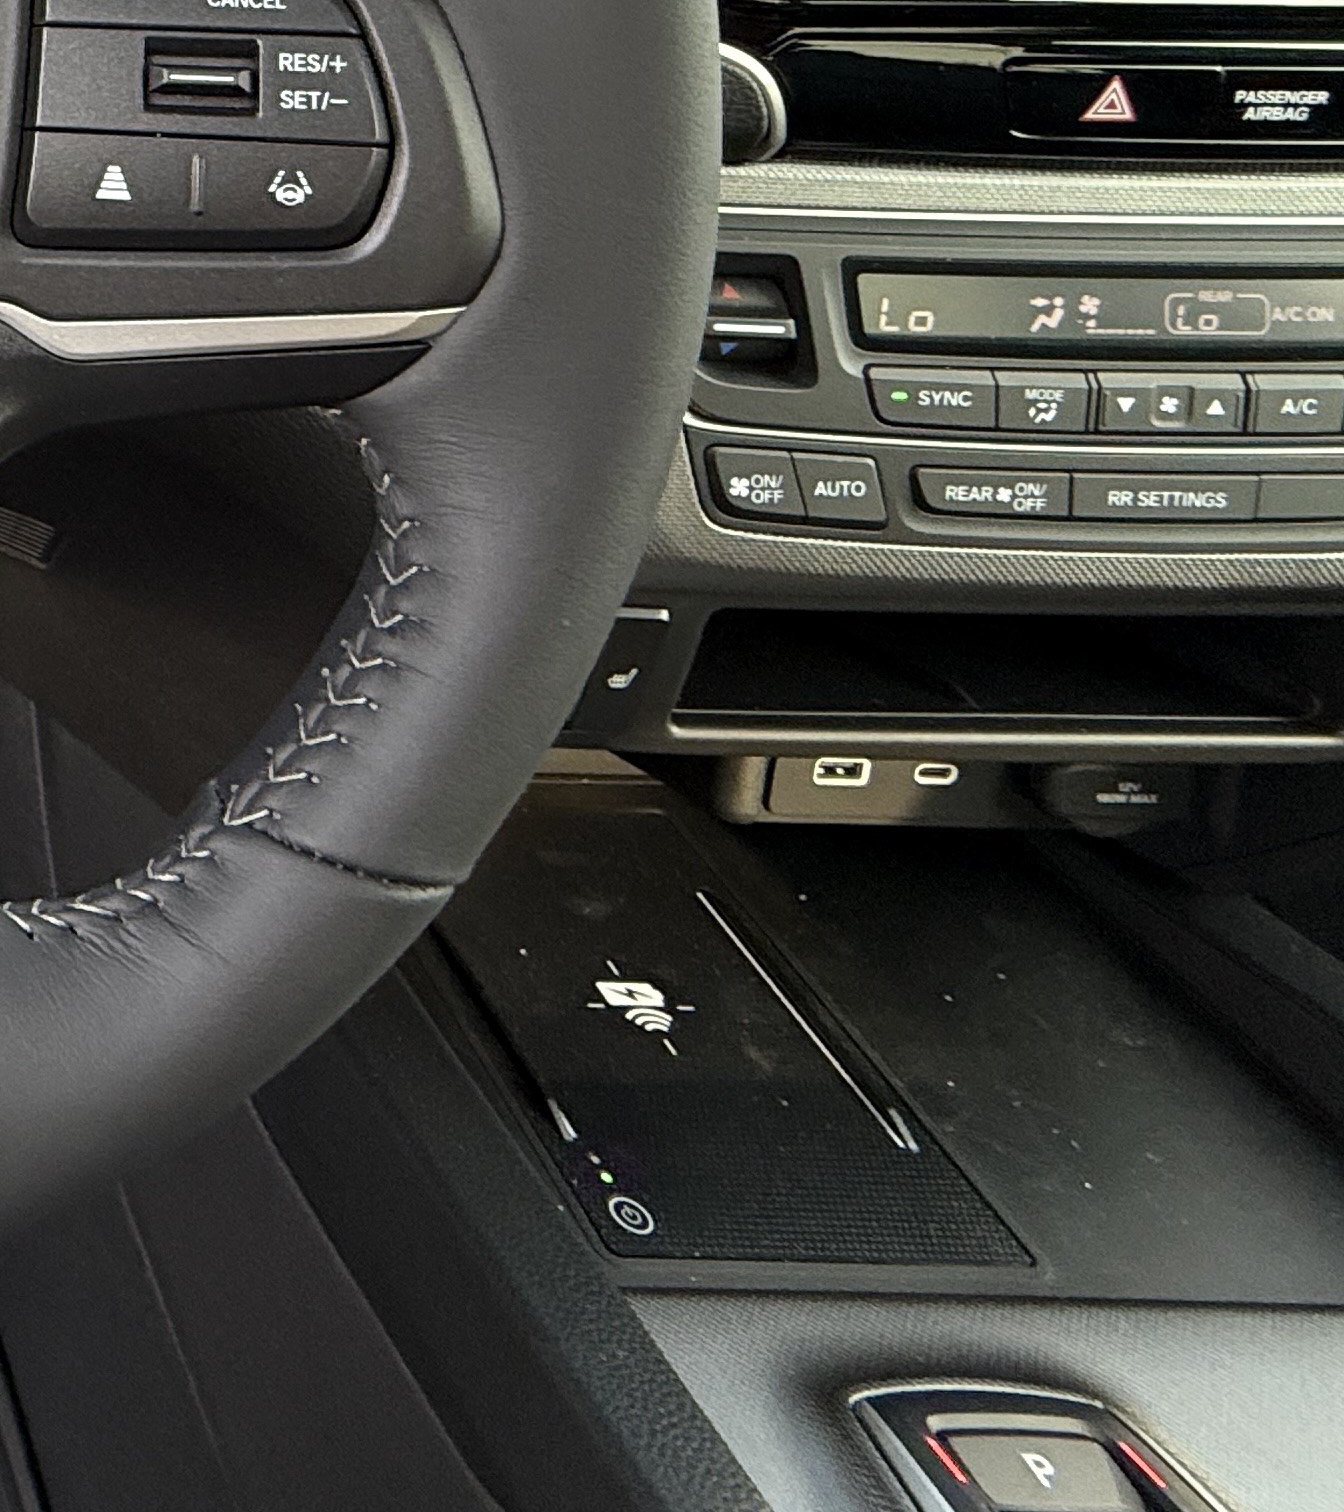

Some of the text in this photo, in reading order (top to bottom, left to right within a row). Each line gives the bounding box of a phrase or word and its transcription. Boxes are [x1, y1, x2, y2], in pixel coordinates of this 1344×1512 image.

[278, 53, 348, 74] RES/+
[1233, 89, 1330, 105] PASSENGER
[1241, 106, 1310, 121] AIRBAG
[1306, 306, 1335, 322] ON
[917, 390, 974, 407] SYNC
[1024, 388, 1065, 402] MODE
[1279, 398, 1319, 416] A/C
[751, 474, 784, 489] ON/
[813, 480, 867, 499] AUTO
[1013, 481, 1047, 497] ON/
[751, 489, 784, 505] OFF
[944, 485, 994, 503] REAR
[1107, 490, 1228, 510] RR SETTINGS
[1012, 496, 1047, 512] OFF
[1020, 1453, 1055, 1489] P
